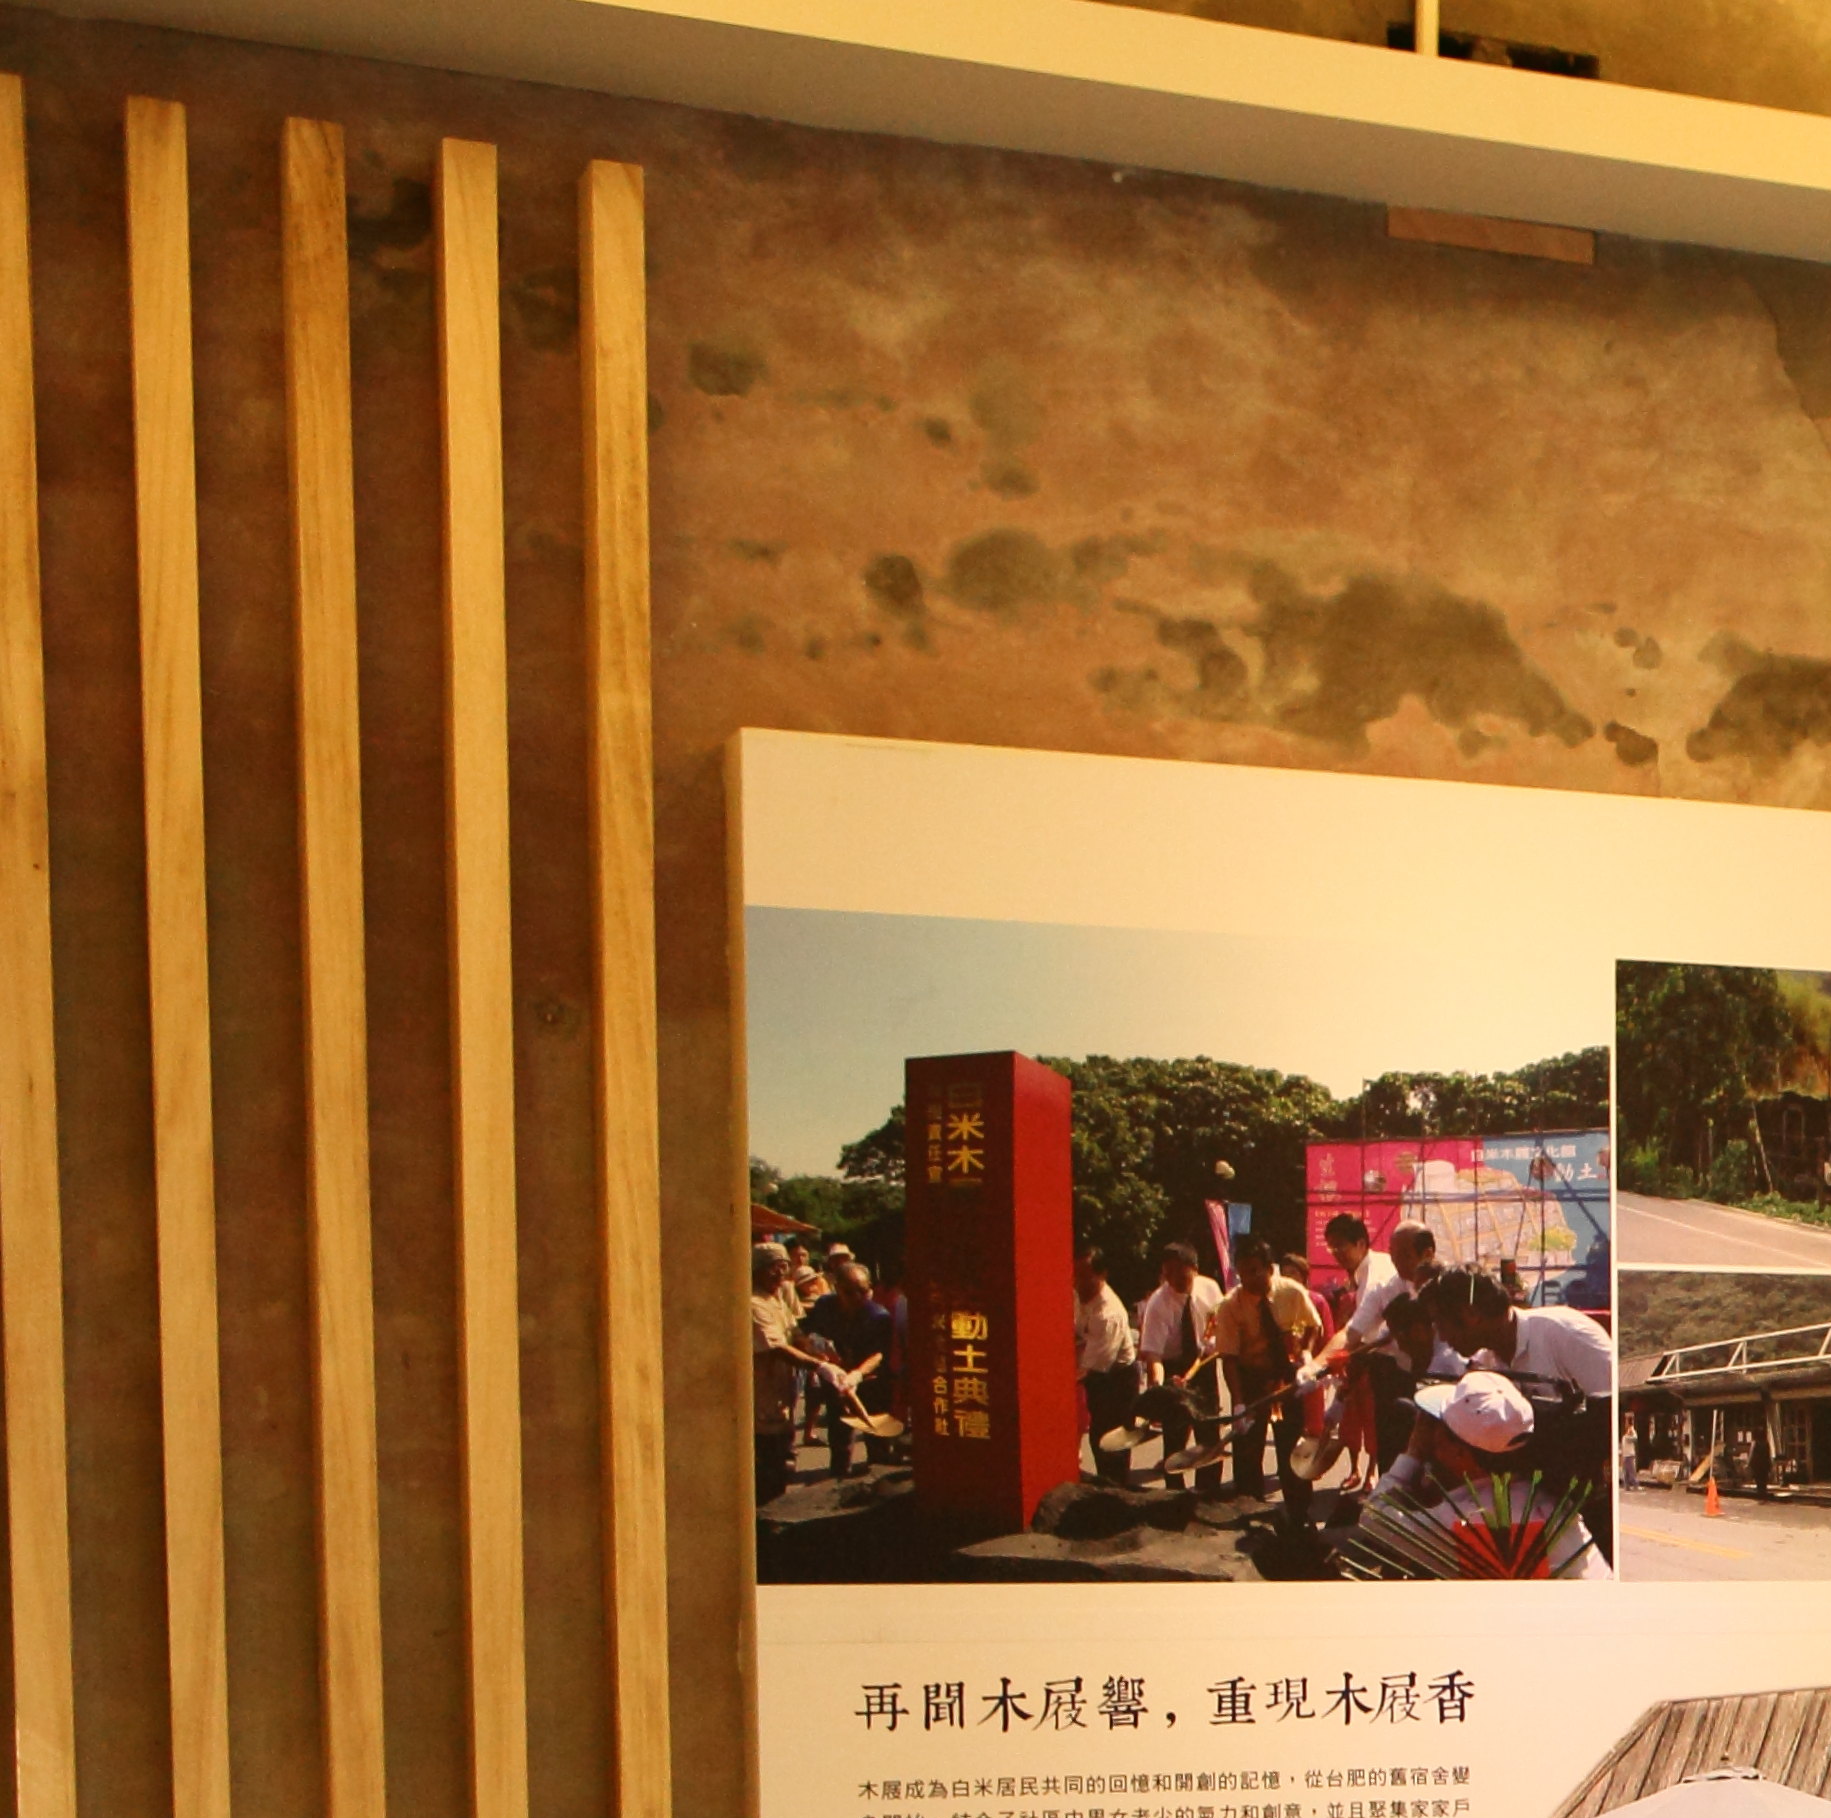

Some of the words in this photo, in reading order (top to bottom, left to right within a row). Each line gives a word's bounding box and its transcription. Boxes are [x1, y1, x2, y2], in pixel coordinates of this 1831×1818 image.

[854, 1668, 1475, 1732] 再聞木屐響，重現木屐香
